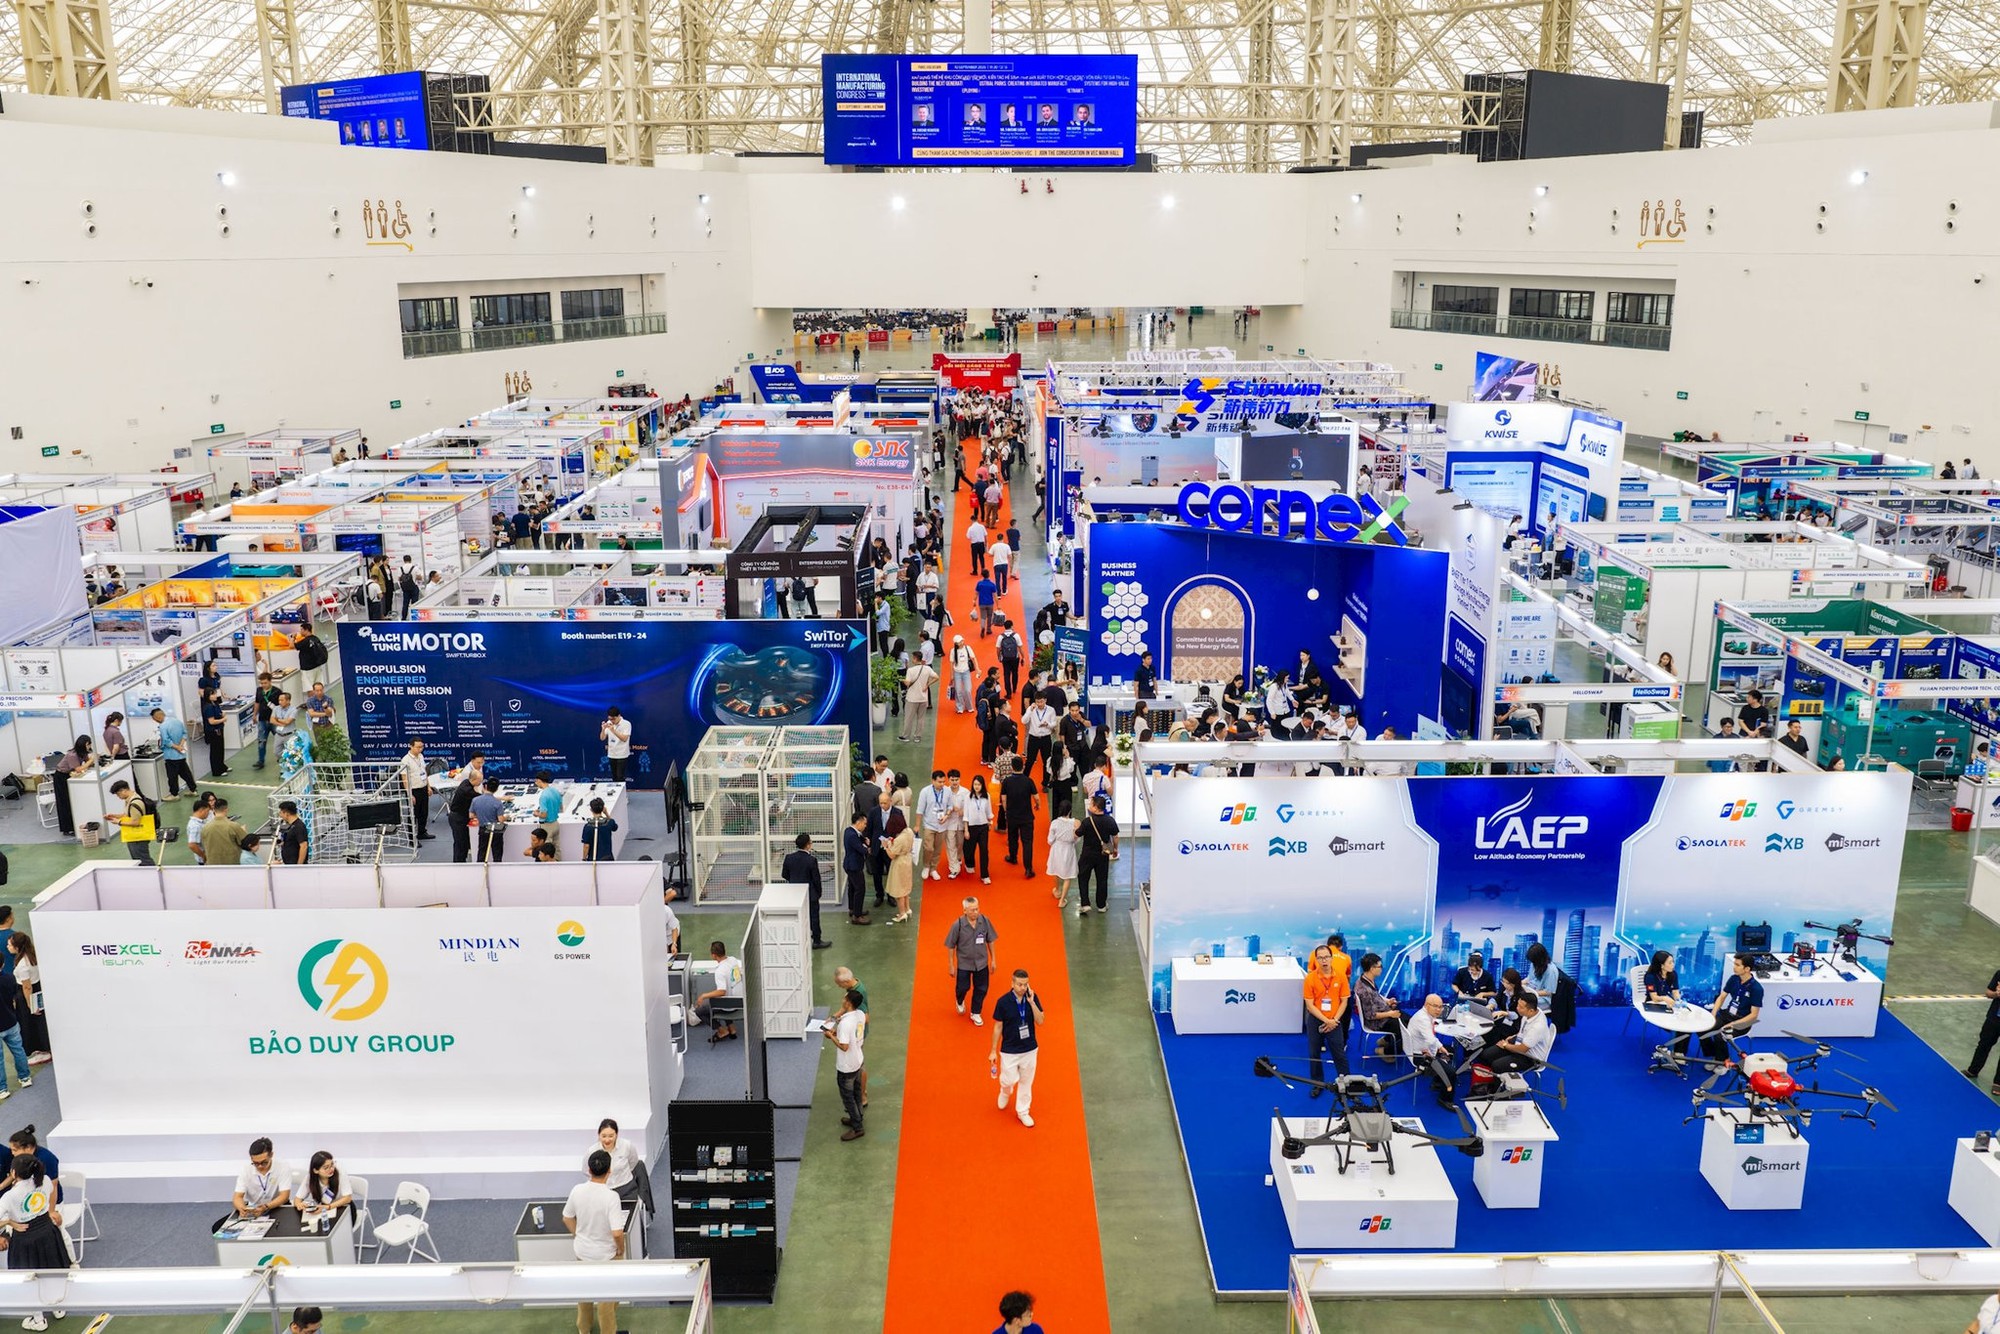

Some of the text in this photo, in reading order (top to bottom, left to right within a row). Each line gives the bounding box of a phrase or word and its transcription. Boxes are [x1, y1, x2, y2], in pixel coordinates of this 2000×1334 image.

[836, 73, 881, 81] INTERNATIONAL
[836, 82, 886, 90] MANUFACTURING
[836, 91, 866, 99] CONGRESS
[1226, 381, 1322, 396] Shinwin
[1224, 399, 1290, 414] 新伟动力
[1485, 430, 1518, 439] KWISE
[856, 458, 909, 469] SNK Energy
[1178, 482, 1411, 546] cornex
[371, 634, 400, 642] BACH
[804, 630, 848, 642] SwiTor
[372, 643, 401, 651] TUNG
[403, 633, 486, 651] MOTOR
[355, 665, 426, 674] PROPULSION
[356, 676, 426, 684] ENGINEERED
[358, 687, 452, 695] FOR THE MISSION
[1635, 688, 1668, 696] HelloSwap
[1475, 816, 1588, 849] LAEP
[1195, 842, 1249, 850] SAOLATEK
[1287, 841, 1307, 853] XB
[1332, 839, 1385, 851] mismart
[1783, 837, 1804, 850] XB
[1828, 837, 1880, 848] mismart
[439, 938, 520, 949] MINDIAN
[82, 945, 161, 955] SINEXCEL
[1239, 992, 1256, 1002] XB
[1795, 998, 1854, 1006] SAOLATEK
[249, 1030, 455, 1054] BẢO DUY GROUP
[1746, 1160, 1800, 1171] mismart
